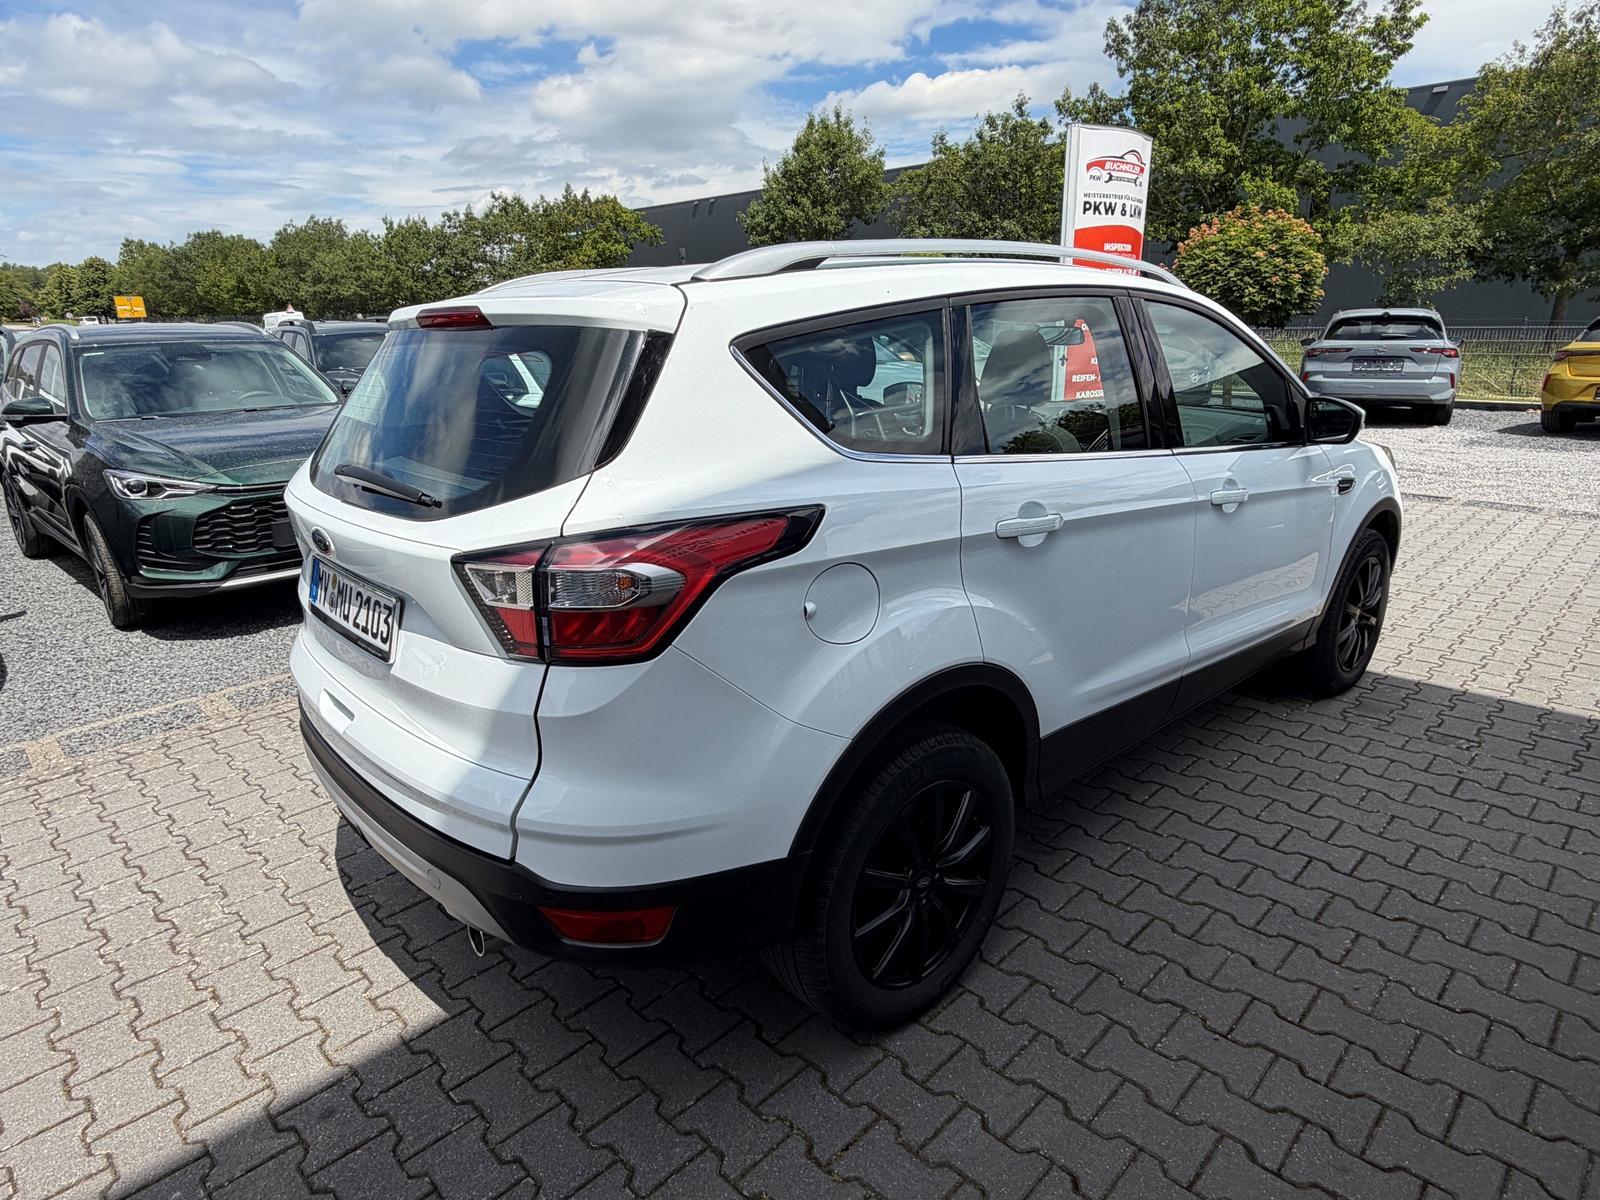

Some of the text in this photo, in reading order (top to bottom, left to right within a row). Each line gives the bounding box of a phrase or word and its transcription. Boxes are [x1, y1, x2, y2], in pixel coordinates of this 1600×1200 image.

[1083, 201, 1117, 216] PKW
[1120, 203, 1127, 217] &
[352, 591, 392, 645] 2103
